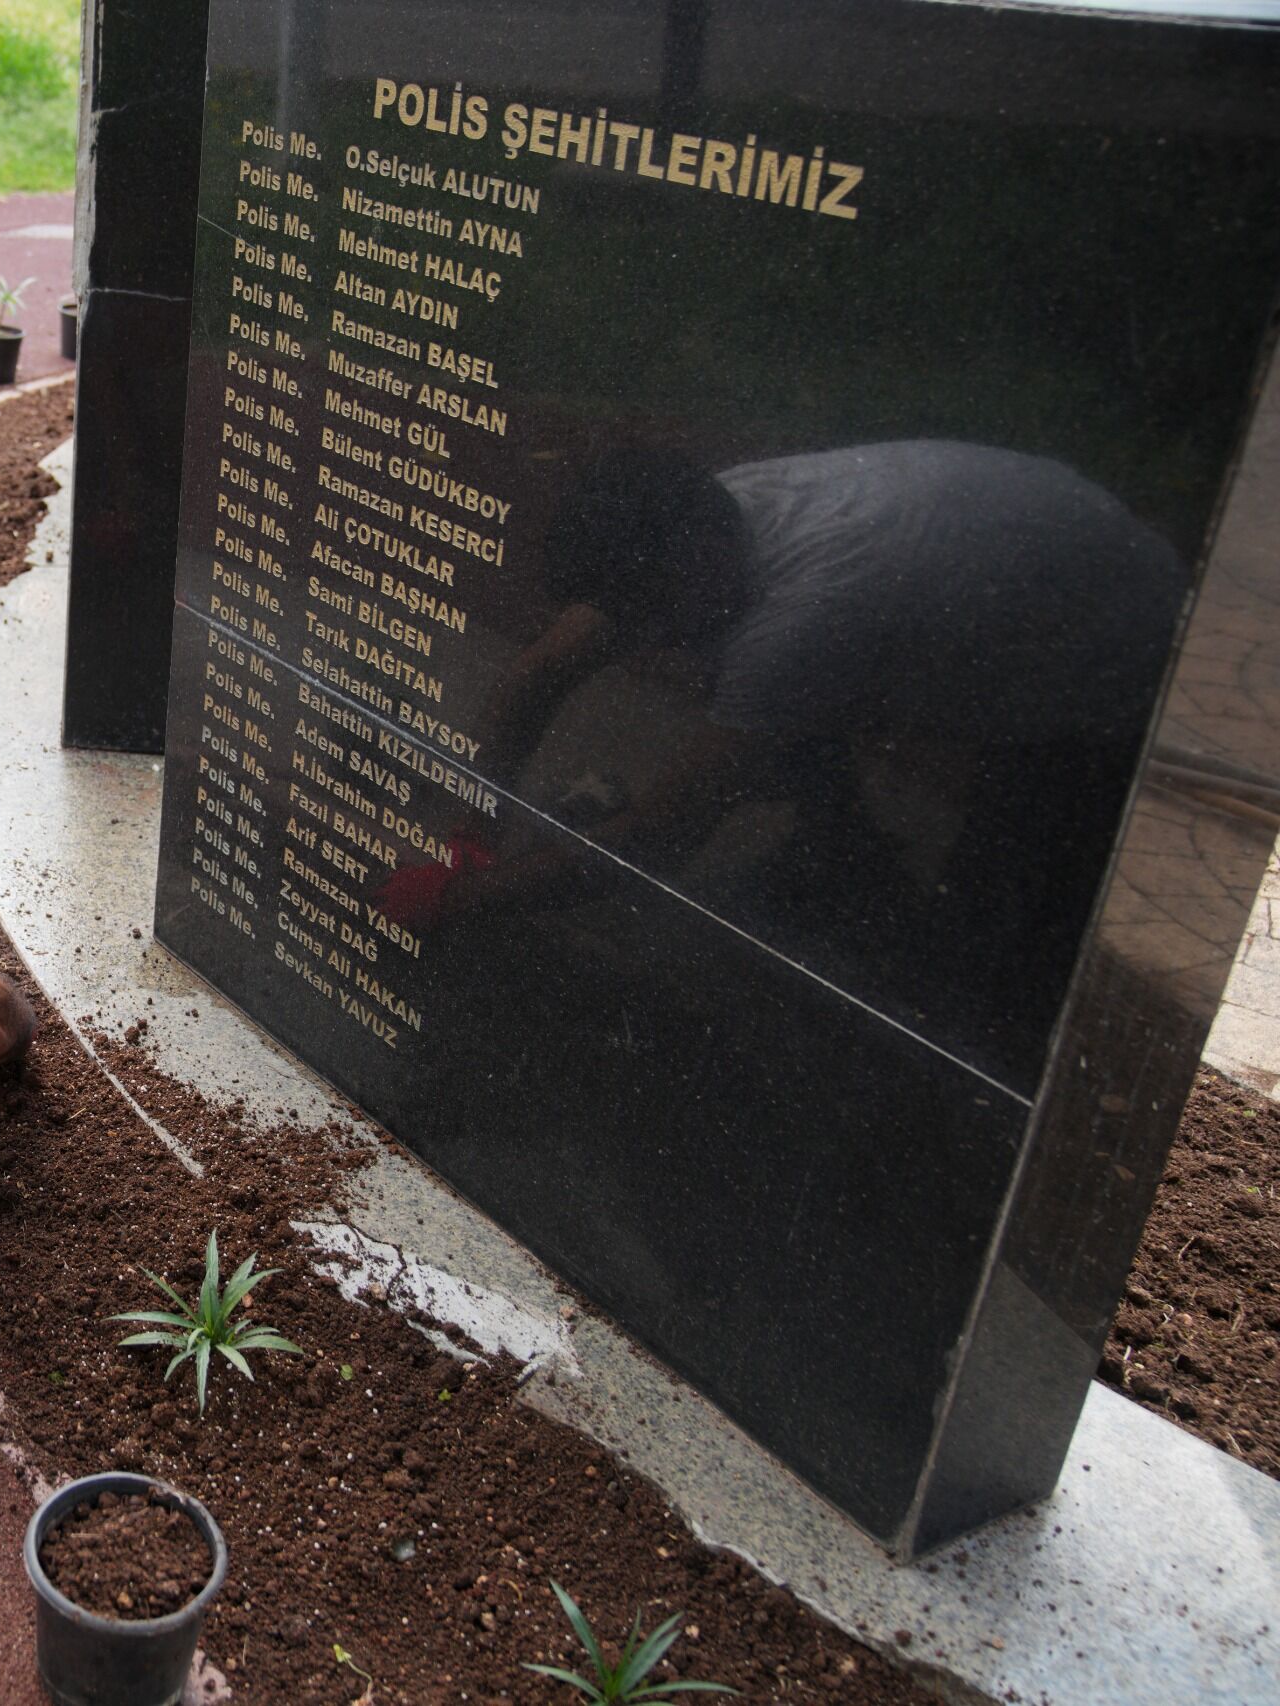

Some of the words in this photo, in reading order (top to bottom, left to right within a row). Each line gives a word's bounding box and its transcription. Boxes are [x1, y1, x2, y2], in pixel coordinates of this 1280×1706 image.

[240, 160, 281, 191] Polis
[287, 173, 318, 201] Me.
[342, 187, 452, 238] Nizamettin
[458, 219, 523, 258] AYNA
[242, 120, 284, 150] Polis
[290, 132, 321, 160] Me.
[346, 145, 436, 188] O.Selçuk
[442, 168, 540, 214] ALUTUN
[373, 77, 488, 139] POLİS
[501, 103, 865, 219] ŞEHİTLERİMİZ
[235, 237, 275, 270] Polis
[281, 253, 312, 282] Me.
[334, 271, 385, 306] Altan
[391, 289, 458, 329] AYDIN
[237, 199, 278, 231] Polis
[284, 213, 315, 243] Me.
[339, 228, 418, 273] Mehmet
[425, 254, 501, 302] HALAÇ
[230, 313, 269, 346] Polis
[276, 330, 305, 360] Me.
[328, 350, 413, 399] Muzaffer
[416, 384, 507, 436] ARSLAN
[232, 276, 272, 308] Polis
[278, 292, 308, 321] Me.
[332, 310, 420, 360] Ramazan
[427, 342, 498, 388] BAŞEL
[225, 387, 264, 420] Polis
[270, 405, 299, 436] Me.
[322, 427, 382, 471] Bülent
[389, 456, 511, 524] GÜDÜKBOY
[227, 350, 267, 383] Polis
[273, 368, 302, 398] Me.
[325, 388, 401, 438] Mehmet
[408, 422, 450, 458] GÜL
[218, 493, 255, 528] Polis
[261, 514, 289, 546] Me.
[311, 540, 374, 588] Afacan
[381, 573, 466, 633] BAŞHAN
[220, 458, 258, 492] Polis
[264, 479, 293, 510] Me.
[314, 504, 339, 531] Ali
[344, 518, 454, 586] ÇOTUKLAR
[223, 423, 261, 456] Polis
[267, 442, 296, 473] Me.
[318, 465, 403, 521] Ramazan
[410, 506, 504, 566] KESERCİ
[213, 561, 250, 597] Polis
[256, 584, 283, 616] Me.
[306, 610, 349, 652] Tarık
[355, 638, 442, 702] DAĞITAN
[215, 528, 253, 562] Polis
[258, 550, 286, 581] Me.
[309, 576, 352, 615] Sami
[358, 600, 431, 656] BİLGEN
[206, 662, 242, 698] Polis
[248, 688, 274, 719] Me.
[295, 719, 343, 762] Adem
[349, 751, 411, 806] SAVAŞ
[209, 629, 244, 665] Polis
[250, 654, 277, 686] Me.
[298, 683, 372, 742] Bahattin
[379, 730, 497, 818] KIZILDEMİR
[211, 595, 247, 630] Polis
[253, 619, 280, 650] Me.
[302, 647, 392, 714] Selahattin
[399, 701, 480, 761] BAYSOY
[200, 755, 234, 794] Polis
[240, 784, 266, 816] Me.
[286, 818, 317, 849] Arif
[321, 840, 368, 883] SERT
[202, 725, 237, 762] Polis
[243, 752, 269, 784] Me.
[290, 783, 328, 823] Fazıl
[333, 812, 396, 870] BAHAR
[204, 694, 239, 730] Polis
[245, 720, 271, 752] Me.
[293, 750, 376, 819] H.İbrahim
[383, 808, 452, 868] DOĞAN
[193, 847, 228, 885] Polis
[232, 876, 258, 909] Me.
[278, 912, 322, 957] Cuma
[328, 950, 350, 978] Ali
[356, 968, 421, 1031] HAKAN
[195, 817, 230, 855] Polis
[235, 846, 261, 879] Me.
[280, 879, 335, 933] Zeyyat
[341, 923, 377, 961] DAĞ
[197, 786, 232, 824] Polis
[237, 815, 263, 848] Me.
[283, 848, 359, 915] Ramazan
[366, 904, 420, 958] YASDI
[191, 877, 225, 914] Polis
[230, 906, 255, 939] Me.
[275, 942, 332, 998] Sevkan
[339, 988, 397, 1048] YAVUZ
